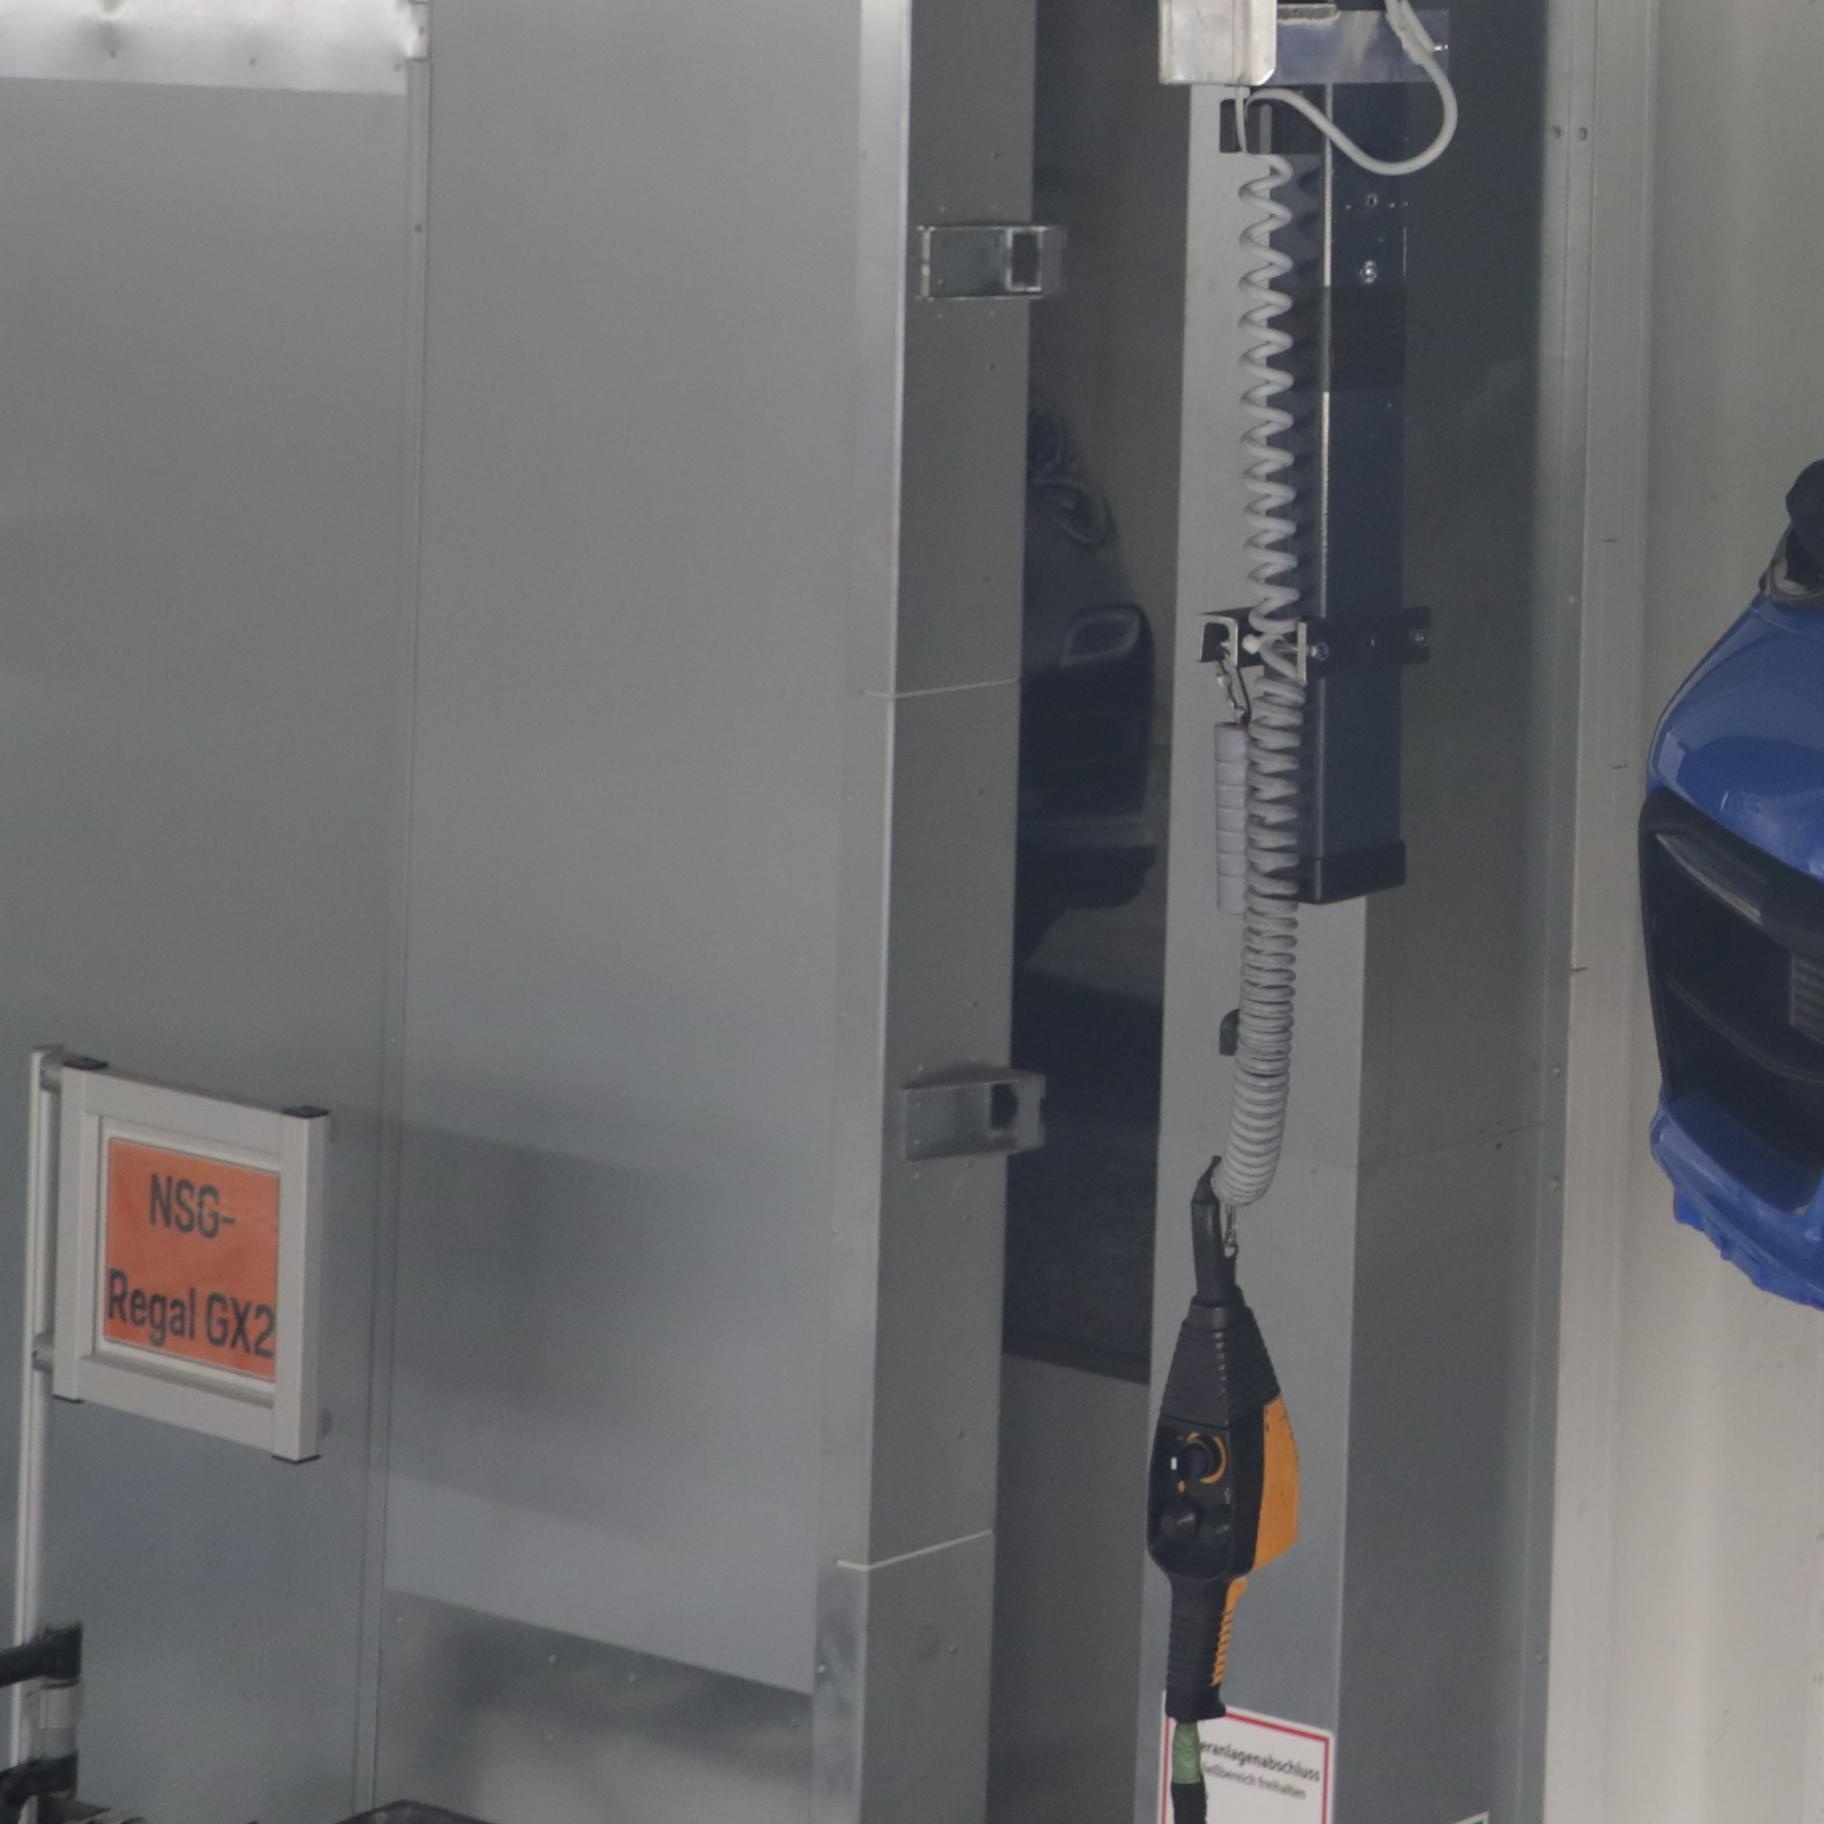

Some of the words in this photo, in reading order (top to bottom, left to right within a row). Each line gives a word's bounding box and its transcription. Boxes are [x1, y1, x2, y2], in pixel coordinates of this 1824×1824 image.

[149, 1173, 236, 1239] NSG-
[107, 1267, 196, 1345] Regal
[205, 1292, 275, 1359] GX2
[1199, 1740, 1320, 1782] eranlagenabschluss
